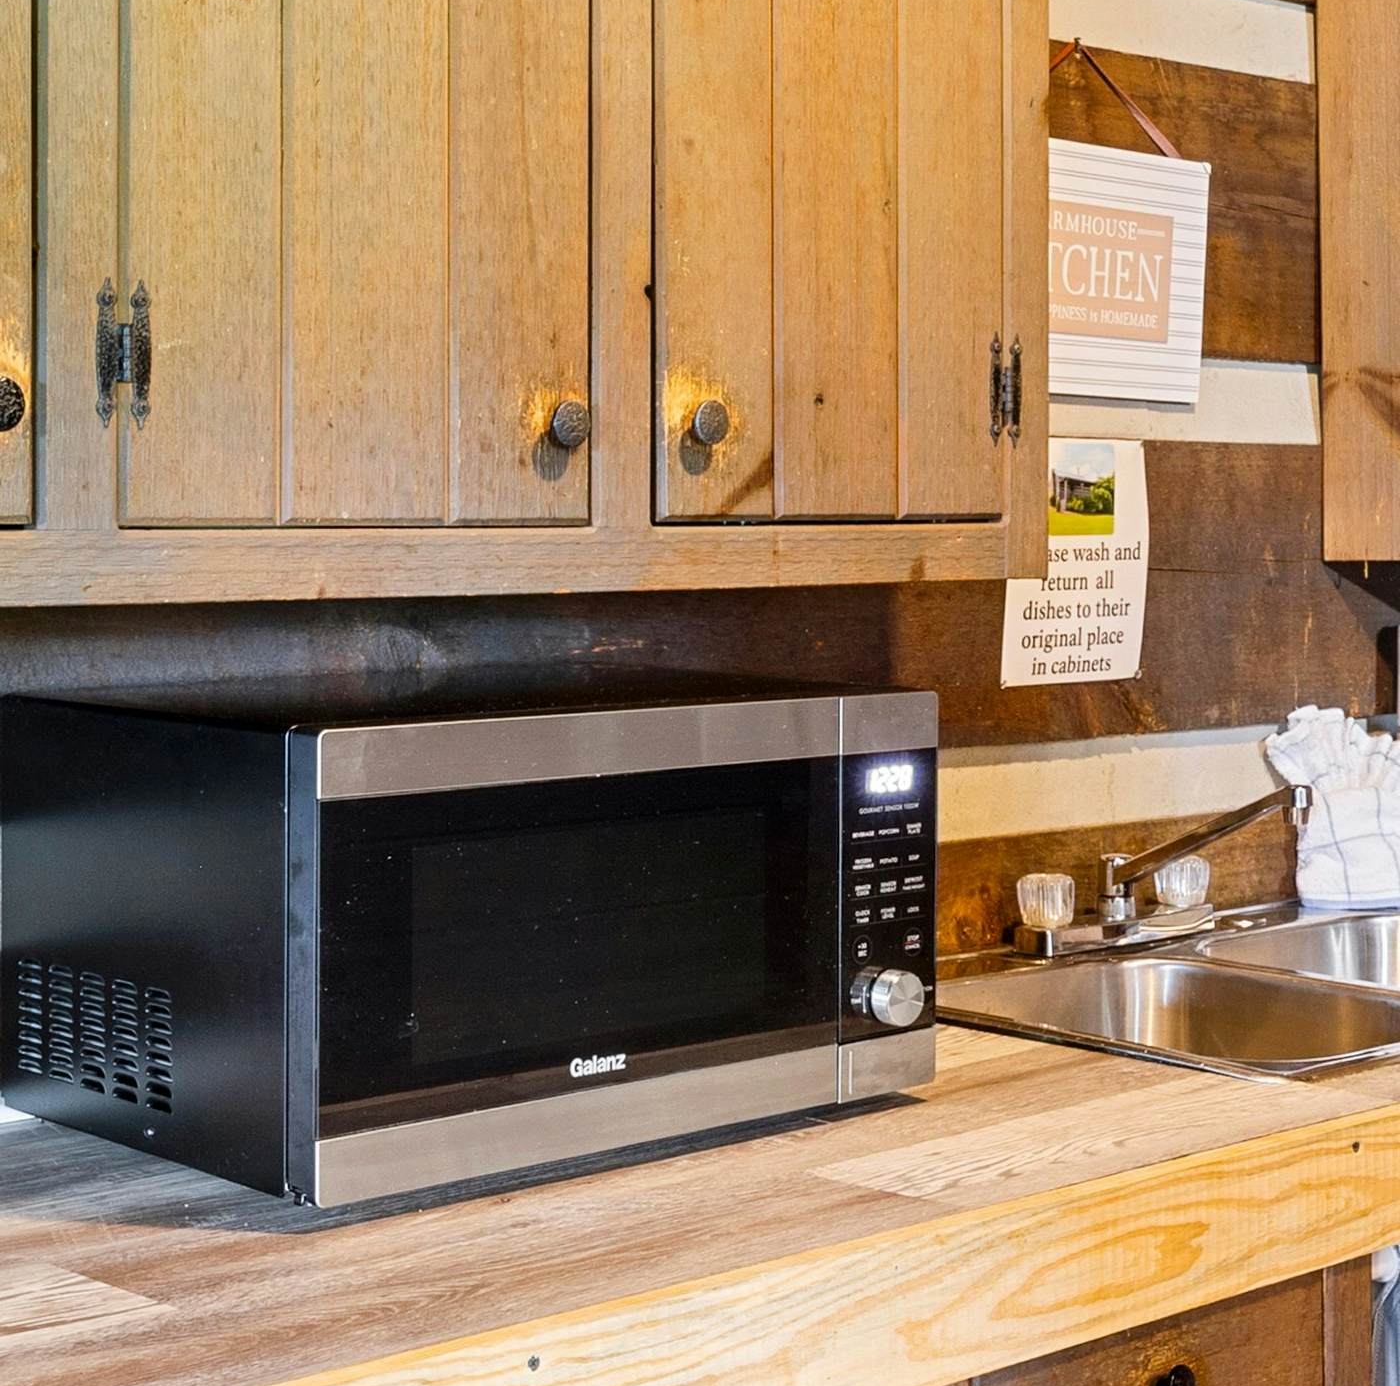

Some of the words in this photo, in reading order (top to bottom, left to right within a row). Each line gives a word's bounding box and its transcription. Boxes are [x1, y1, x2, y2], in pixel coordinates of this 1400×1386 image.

[1048, 210, 1138, 241] RMHOUSE
[1100, 309, 1158, 329] HOMEMADE
[1073, 542, 1110, 561] wash
[1114, 541, 1141, 561] and
[1041, 575, 1088, 591] return
[1095, 570, 1114, 590] all
[1023, 600, 1072, 620] dishes
[1077, 602, 1092, 619] to
[1096, 598, 1131, 617] their
[1021, 627, 1082, 653] original
[1087, 626, 1124, 651] place
[1031, 657, 1047, 676] in
[1051, 655, 1111, 675] cabinets
[569, 1053, 627, 1078] Galanz
